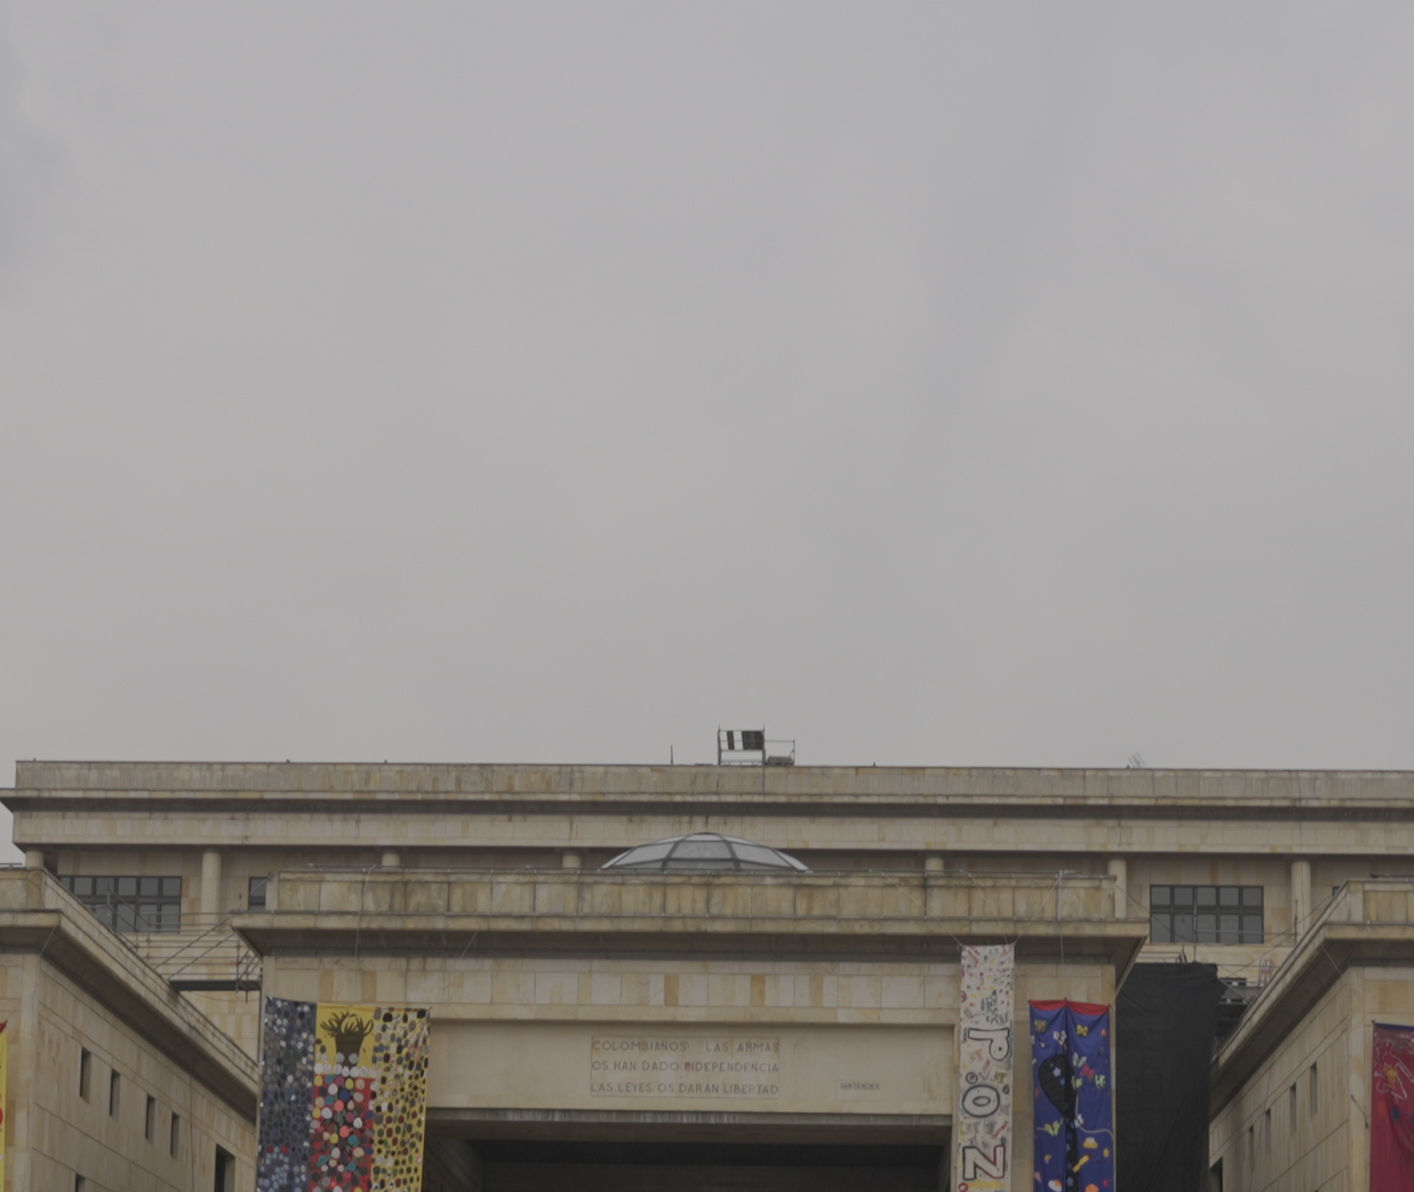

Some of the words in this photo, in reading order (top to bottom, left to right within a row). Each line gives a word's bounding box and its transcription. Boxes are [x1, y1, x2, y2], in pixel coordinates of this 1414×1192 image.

[592, 1041, 686, 1051] COLOMBIANOS
[706, 1042, 729, 1052] LAS
[737, 1042, 779, 1053] ARMAS
[592, 1061, 609, 1071] OS
[614, 1062, 636, 1071] HAN
[642, 1062, 679, 1071] DADO
[684, 1062, 779, 1073] INDEPENDENCIA
[591, 1082, 613, 1092] LAS
[618, 1083, 652, 1092] LEYES
[657, 1083, 674, 1093] OS
[679, 1084, 719, 1094] DARAN
[723, 1084, 779, 1095] LIBERTAD
[840, 1083, 880, 1091] SANTANDER
